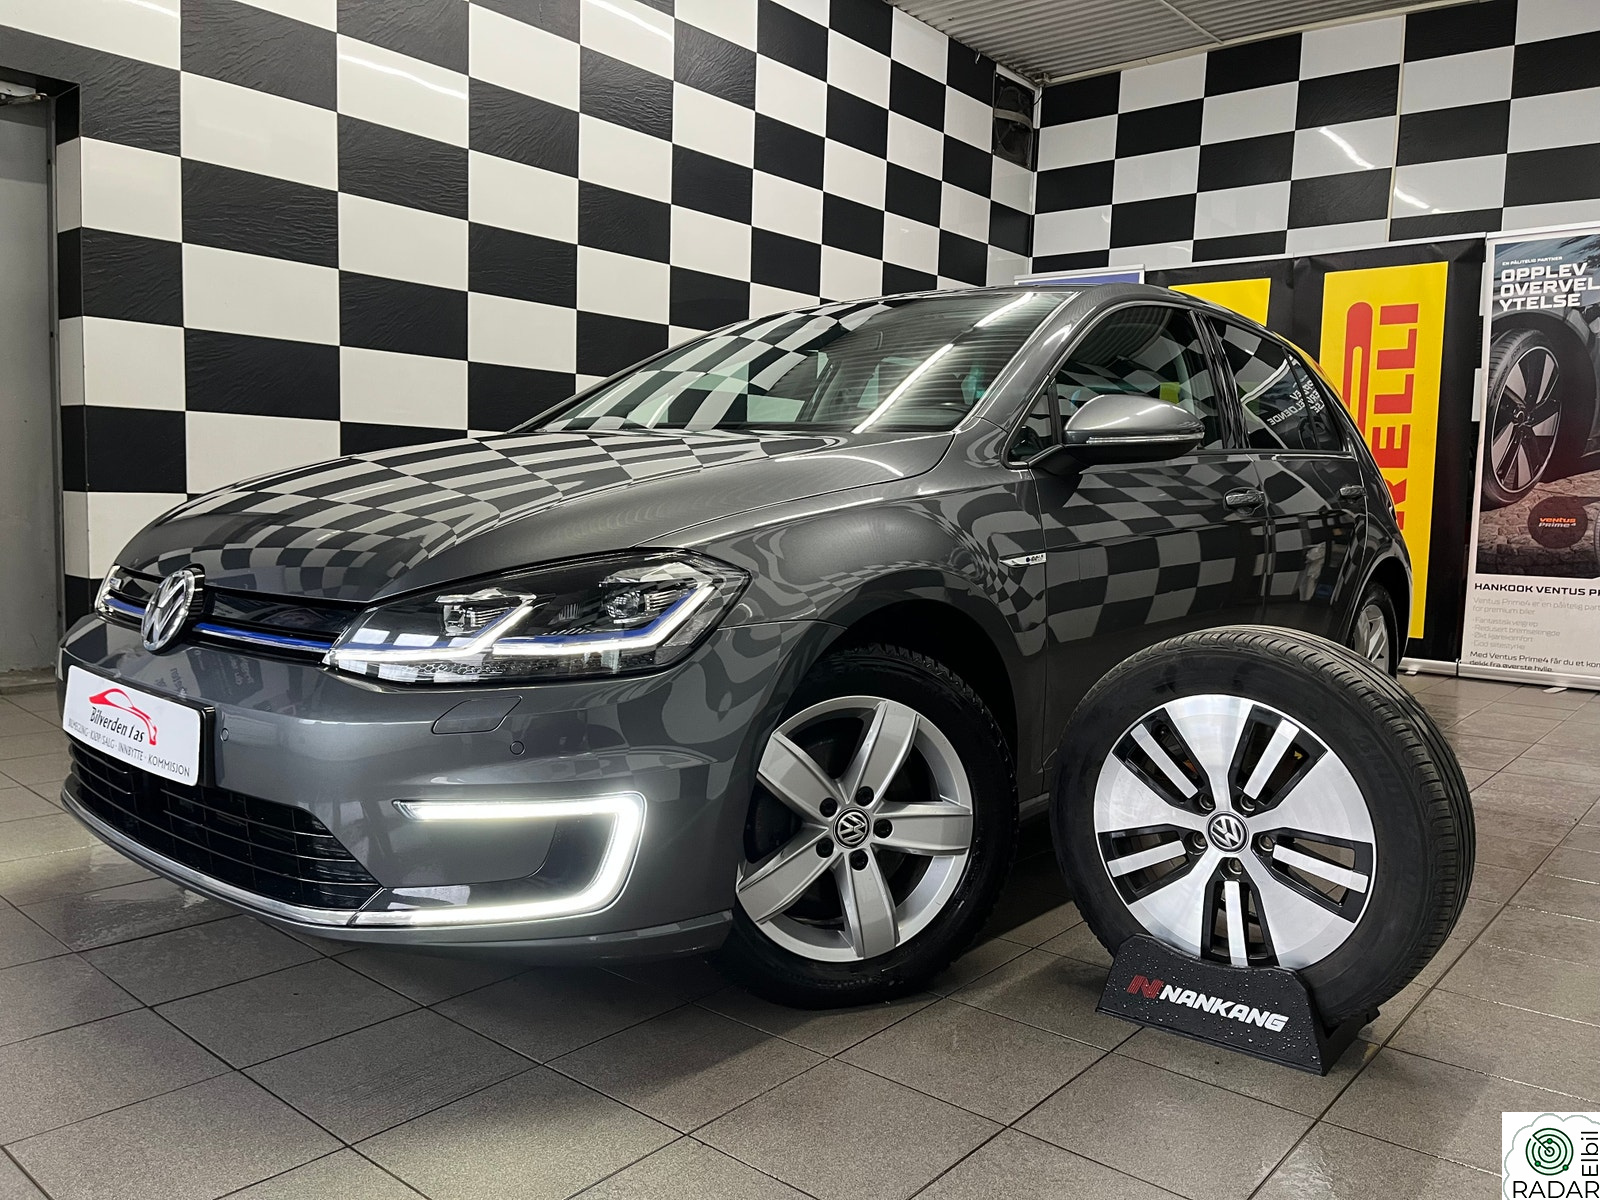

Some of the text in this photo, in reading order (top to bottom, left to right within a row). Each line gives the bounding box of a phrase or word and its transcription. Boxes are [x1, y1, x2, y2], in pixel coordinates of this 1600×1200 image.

[1501, 262, 1588, 283] OPPLEV
[1499, 293, 1581, 311] YTELSE
[1474, 583, 1534, 593] HANKOOK
[1536, 586, 1586, 596] VENTUS
[1473, 597, 1501, 606] Ventus
[1472, 604, 1536, 615] for premium biler
[1470, 651, 1488, 659] Med
[1489, 652, 1517, 661] Ventus
[1518, 654, 1549, 664] Prime4
[1550, 656, 1562, 665] får
[1563, 658, 1574, 666] du
[1502, 663, 1533, 671] øverste
[89, 707, 128, 736] Bilverden
[133, 728, 145, 743] as
[1159, 984, 1290, 1033] NANKANG
